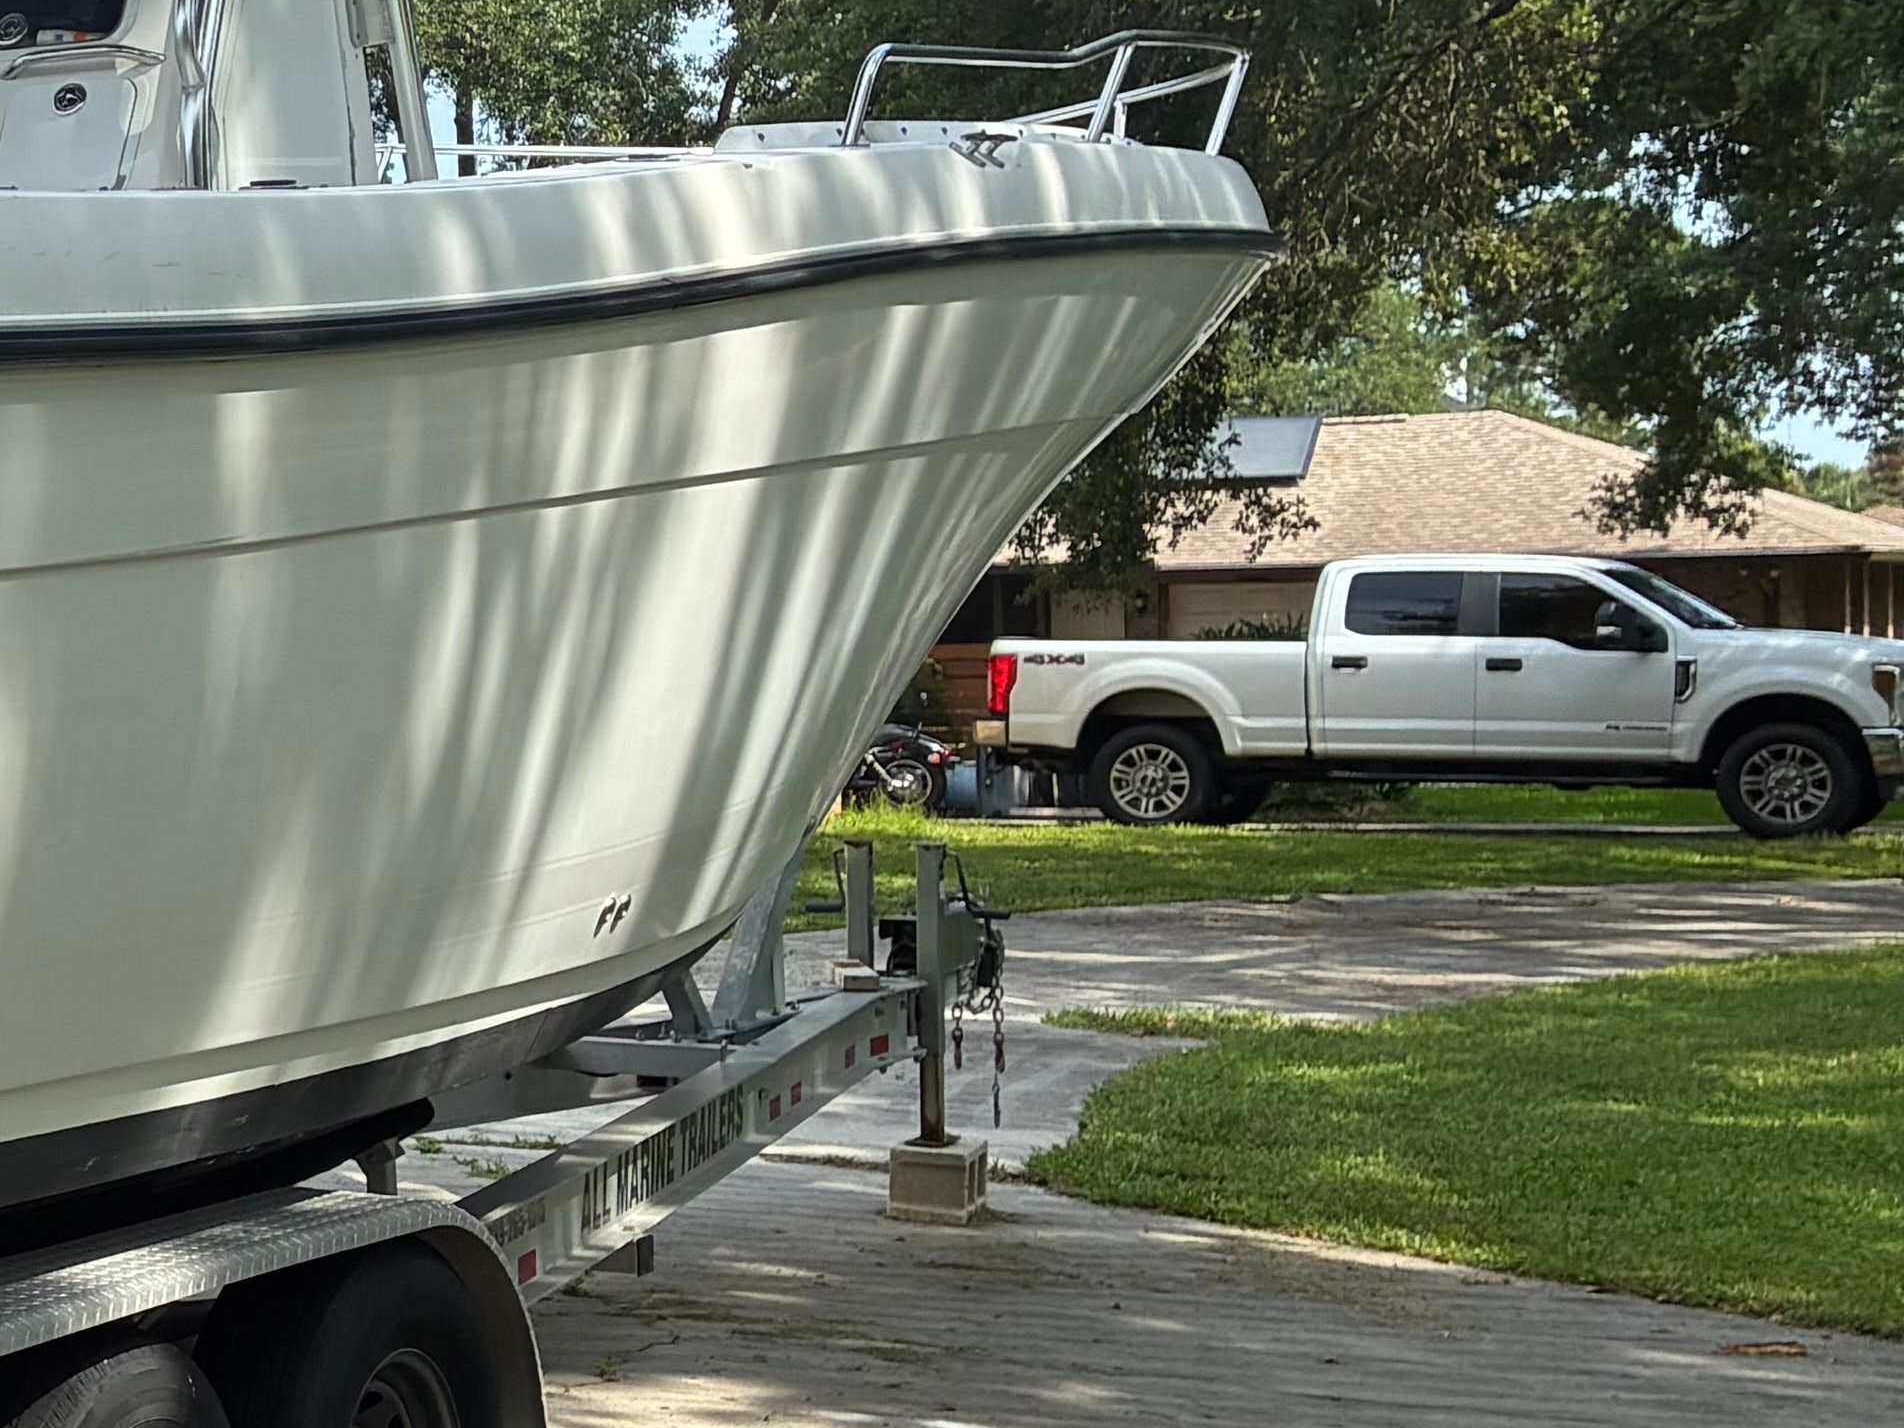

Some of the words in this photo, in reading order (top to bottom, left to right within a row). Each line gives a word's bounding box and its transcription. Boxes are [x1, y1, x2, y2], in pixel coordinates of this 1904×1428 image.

[580, 1160, 611, 1234] ALL
[616, 1123, 675, 1218] MARINE
[679, 1082, 744, 1178] TRAILERS
